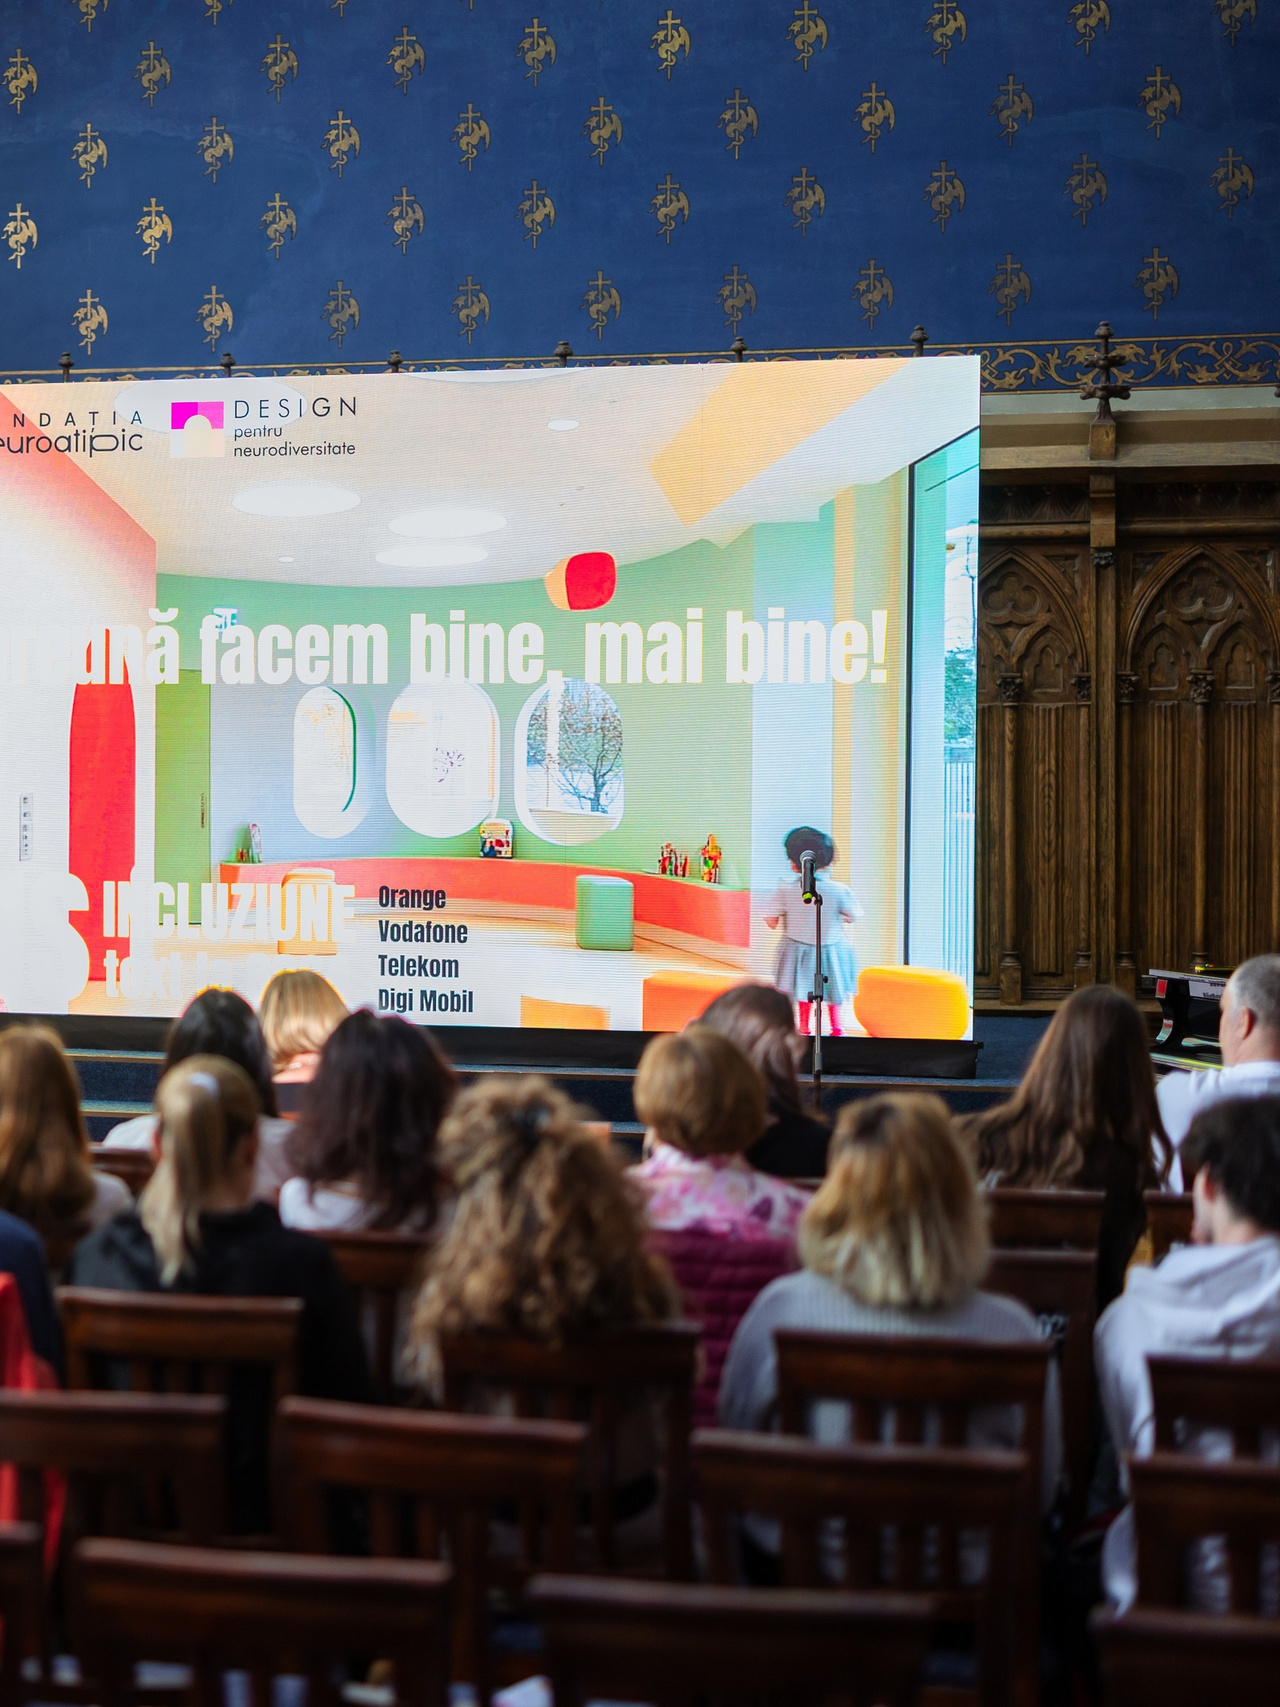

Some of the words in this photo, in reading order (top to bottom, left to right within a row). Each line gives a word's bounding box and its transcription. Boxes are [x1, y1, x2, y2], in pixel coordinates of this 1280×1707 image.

[234, 396, 356, 419] DESIGN
[234, 425, 282, 441] pentru
[234, 440, 356, 457] neurodiversitate
[198, 613, 389, 685] facem
[410, 609, 564, 692] bine,
[585, 607, 704, 684] mai
[726, 607, 889, 684] bine!
[378, 885, 447, 911] Orange
[103, 881, 356, 943] INCLUZIUNE
[378, 919, 469, 944] Vodafone
[103, 949, 183, 999] text
[378, 954, 460, 978] Telekom
[378, 988, 414, 1013] Digi
[420, 989, 474, 1013] Mobil
